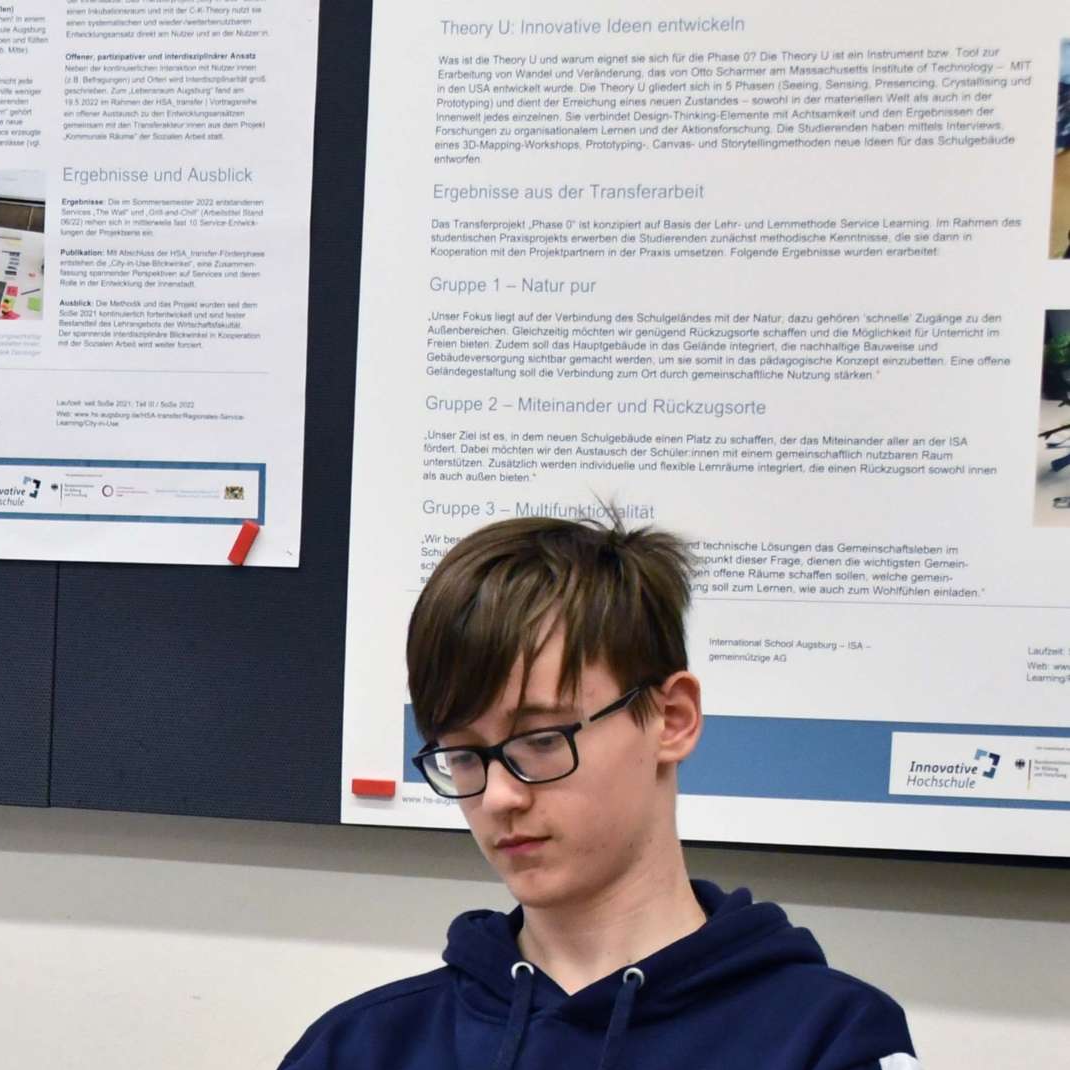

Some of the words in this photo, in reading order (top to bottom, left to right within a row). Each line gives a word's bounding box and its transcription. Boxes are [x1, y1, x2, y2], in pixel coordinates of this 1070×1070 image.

[440, 19, 492, 38] Theory
[498, 19, 514, 35] U:
[521, 19, 600, 34] Innovative
[607, 18, 652, 33] Ideen
[658, 16, 744, 32] entwickeln
[97, 53, 145, 61] partizipativer
[164, 52, 227, 60] interdisziplinärer
[230, 52, 256, 60] Ansatz
[439, 55, 459, 65] Was
[462, 55, 472, 65] ist
[475, 55, 490, 65] die
[494, 54, 526, 66] Theory
[529, 54, 536, 65] U
[540, 54, 558, 65] und
[561, 56, 594, 64] warum
[597, 54, 628, 66] eignet
[631, 55, 645, 63] sie
[648, 53, 668, 63] sich
[672, 52, 685, 63] für
[688, 52, 704, 63] die
[707, 51, 740, 62] Phase
[743, 51, 756, 62] 0?
[760, 50, 777, 61] Die
[782, 50, 817, 62] Theory
[821, 50, 828, 61] U
[832, 50, 844, 60] ist
[847, 50, 863, 60] ein
[867, 49, 923, 59] Instrument
[957, 47, 979, 58] Tool
[982, 48, 998, 57] zur
[63, 166, 148, 185] Ergebnisse
[154, 167, 182, 182] und
[188, 167, 252, 182] Ausblick
[433, 183, 519, 202] Ergebnisse
[524, 187, 552, 199] aus
[558, 184, 583, 199] der
[590, 183, 703, 199] Transferarbeit
[429, 276, 486, 295] Gruppe
[493, 277, 499, 292] 1
[522, 277, 564, 293] Natur
[570, 281, 596, 296] pur
[462, 311, 492, 322] Fokus
[495, 312, 515, 324] liegt
[518, 311, 534, 322] auf
[536, 312, 552, 322] der
[555, 312, 612, 324] Verbindung
[615, 313, 633, 323] des
[636, 312, 711, 325] Schulgeländes
[714, 314, 730, 323] mit
[733, 313, 749, 323] der
[788, 313, 813, 324] dazu
[816, 313, 859, 325] gehören
[915, 312, 962, 326] Zugänge
[966, 315, 978, 323] zu
[983, 313, 1001, 323] den
[425, 395, 482, 413] Gruppe
[488, 396, 497, 411] 2
[518, 397, 612, 413] Miteinander
[617, 399, 647, 413] und
[653, 398, 766, 417] Rückzugsorte
[422, 471, 436, 480] als
[439, 471, 462, 481] auch
[465, 471, 496, 482] außen
[422, 500, 480, 517] Gruppe
[485, 502, 495, 515] 3
[712, 582, 728, 592] soll
[732, 584, 753, 592] zum
[799, 585, 816, 594] wie
[819, 585, 844, 594] auch
[848, 586, 869, 595] zum
[873, 585, 930, 596] Wohlfühlen
[708, 638, 762, 647] International
[764, 639, 794, 648] School
[795, 640, 837, 651] Augsburg
[847, 641, 863, 650] ISA
[708, 653, 770, 663] gemeinnützige
[773, 653, 786, 662] AG
[910, 761, 978, 774] Innovative
[906, 775, 976, 788] Hochschule
